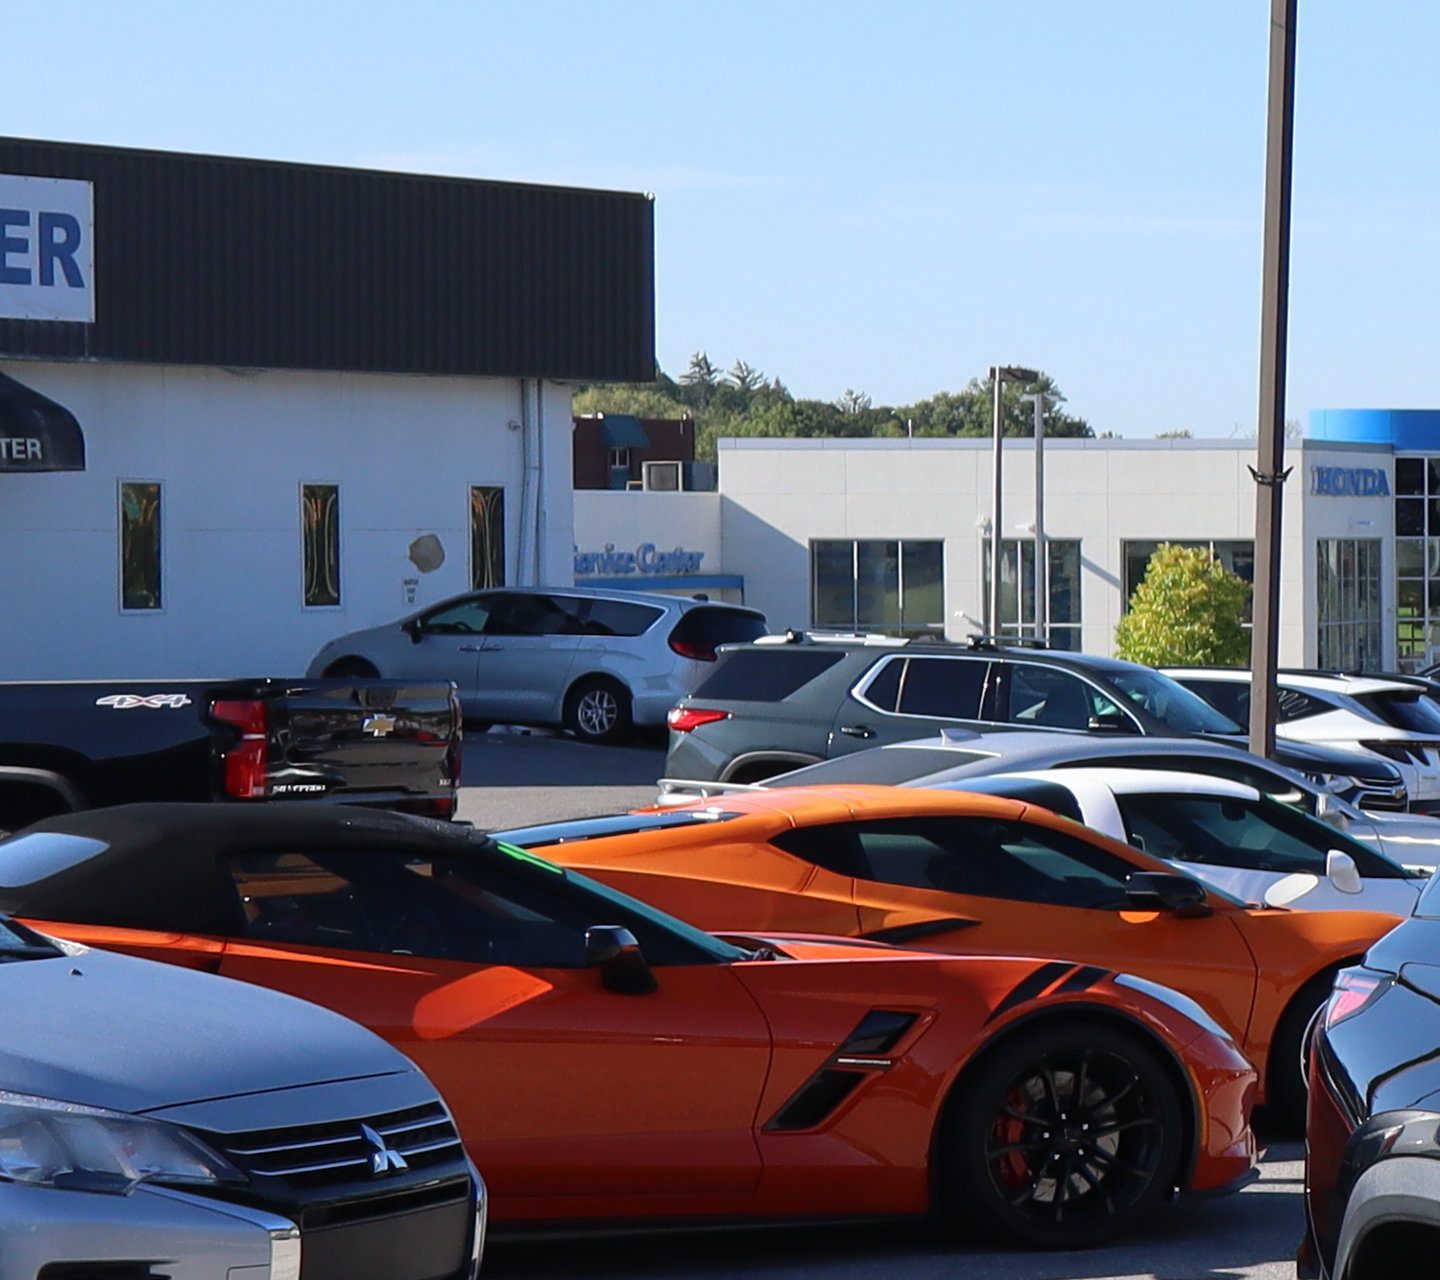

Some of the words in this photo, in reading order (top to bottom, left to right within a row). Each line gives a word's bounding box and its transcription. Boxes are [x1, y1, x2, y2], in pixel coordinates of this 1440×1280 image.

[0, 208, 85, 289] ER
[0, 437, 43, 460] TER
[1311, 465, 1391, 497] HONDA
[573, 543, 637, 574] ervice
[637, 542, 705, 573] Center
